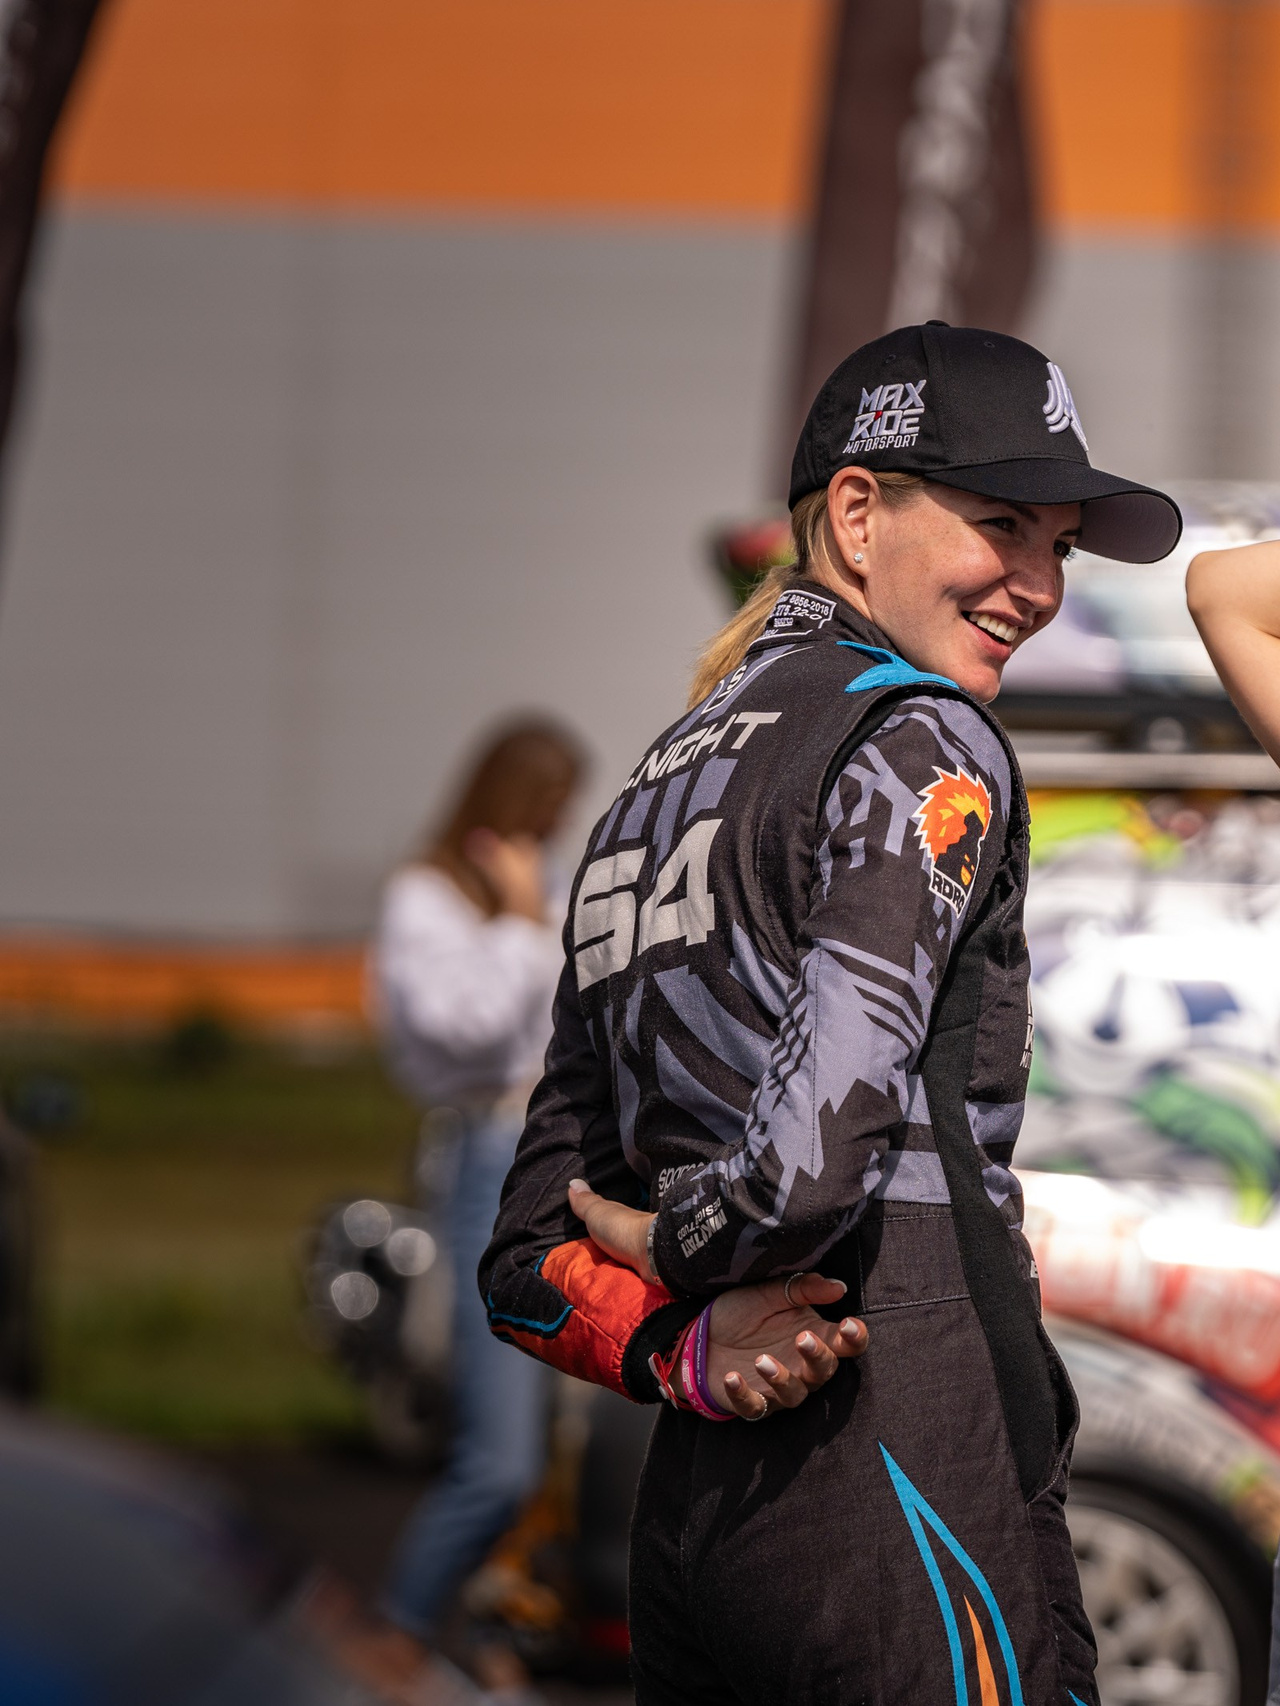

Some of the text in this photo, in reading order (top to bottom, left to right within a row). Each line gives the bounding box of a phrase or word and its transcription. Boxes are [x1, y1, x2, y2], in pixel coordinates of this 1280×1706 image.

[858, 380, 926, 415] MAX
[842, 433, 919, 454] MOTORSPORT
[574, 818, 715, 994] 54
